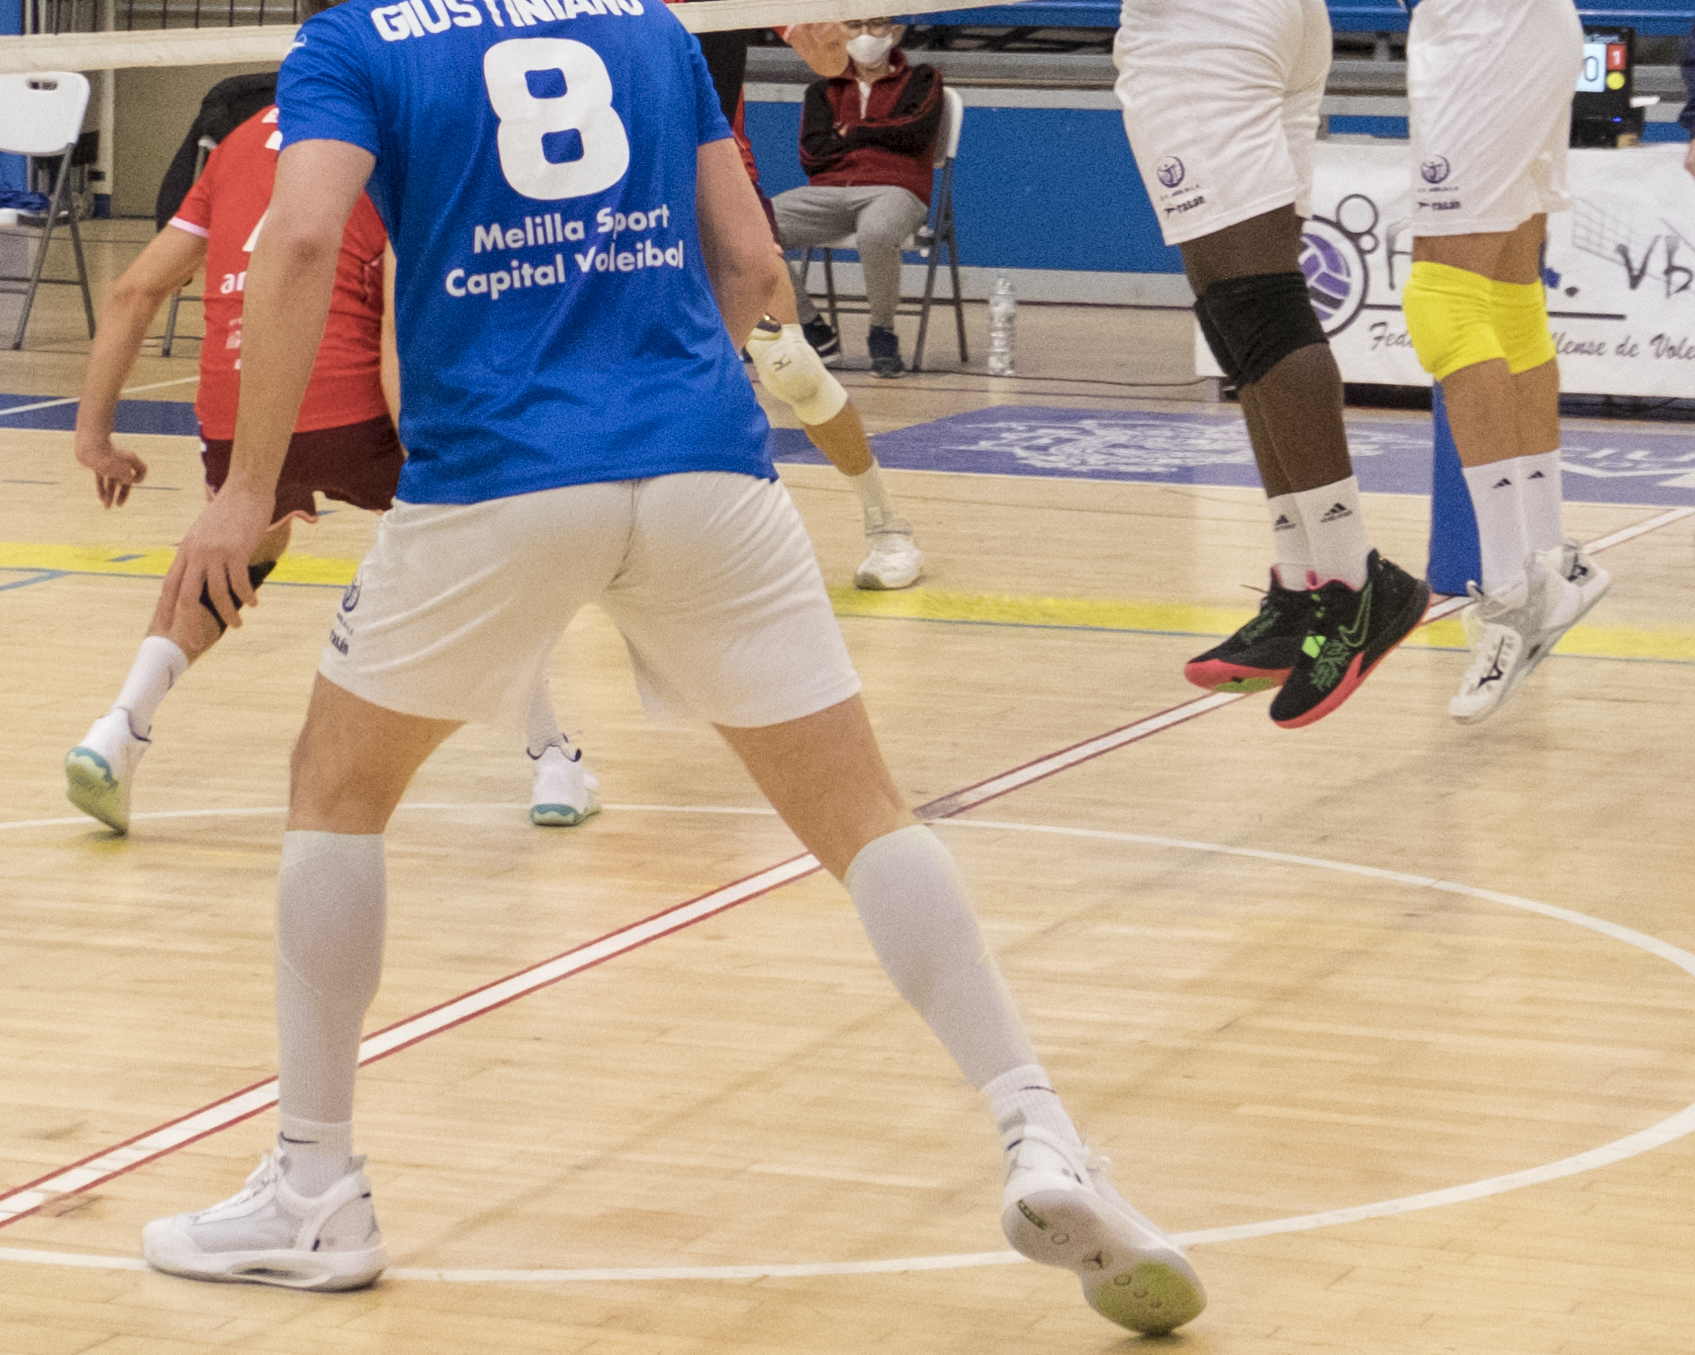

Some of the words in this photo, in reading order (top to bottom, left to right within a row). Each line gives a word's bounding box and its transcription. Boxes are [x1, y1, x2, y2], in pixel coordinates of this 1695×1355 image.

[1612, 49, 1622, 66] 1
[482, 36, 630, 201] 8
[473, 212, 586, 254] Melilla
[596, 204, 670, 240] Sport
[445, 253, 566, 300] Capital
[574, 238, 684, 273] Voleibol
